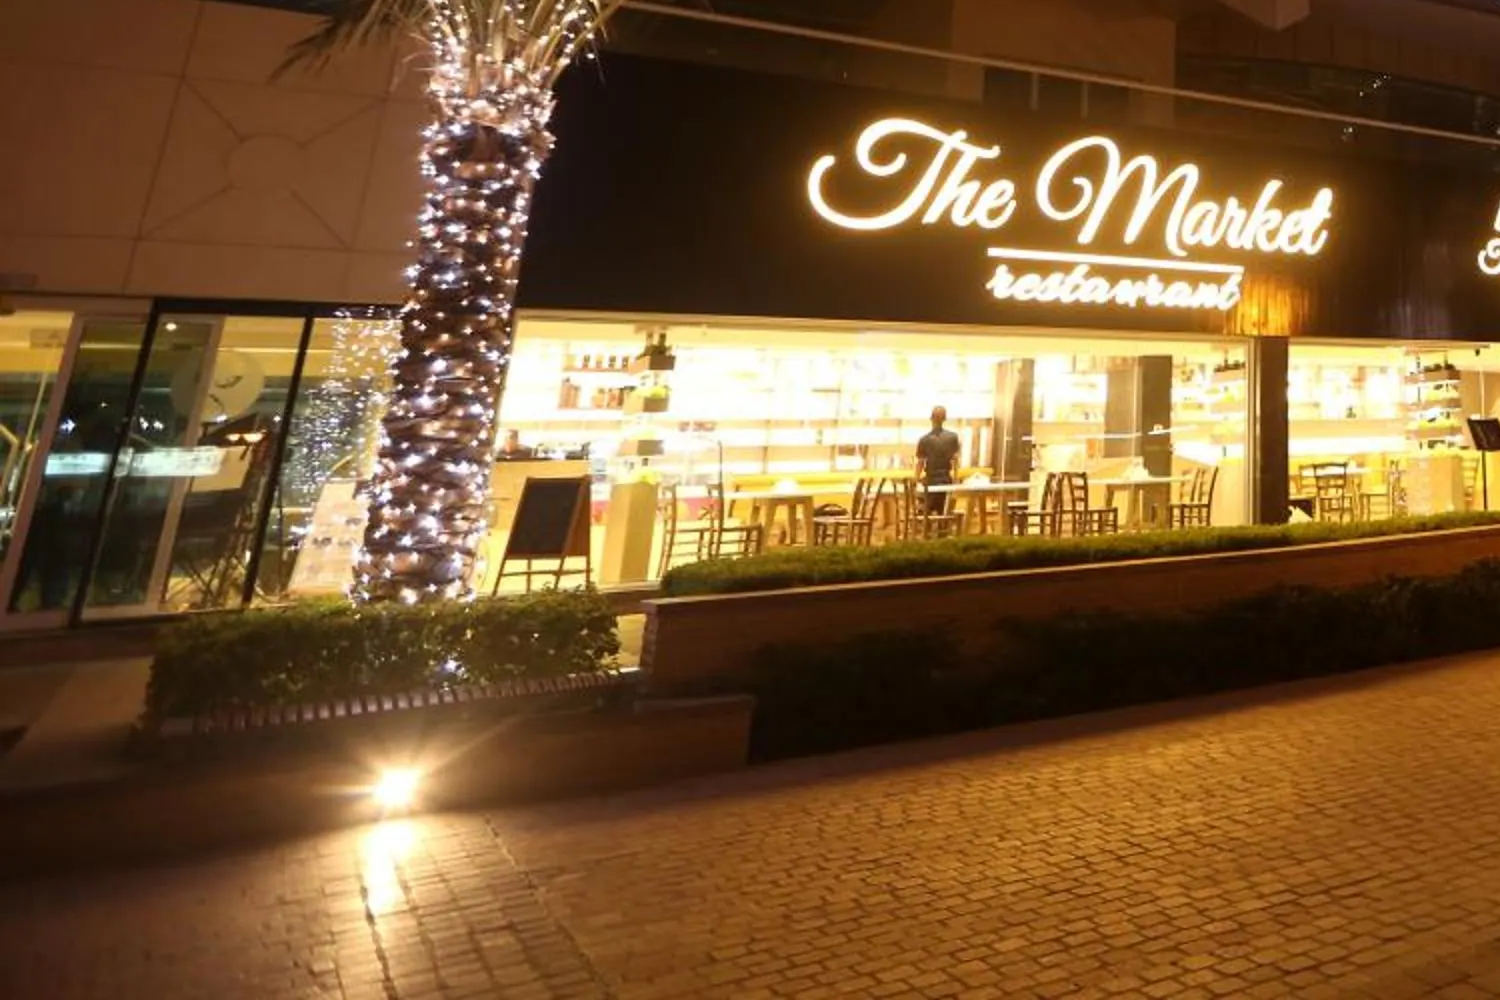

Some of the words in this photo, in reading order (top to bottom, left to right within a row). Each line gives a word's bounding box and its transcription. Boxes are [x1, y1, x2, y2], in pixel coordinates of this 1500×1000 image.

[806, 116, 1018, 231] The
[1034, 134, 1335, 258] Market
[986, 263, 1244, 310] restaurant
